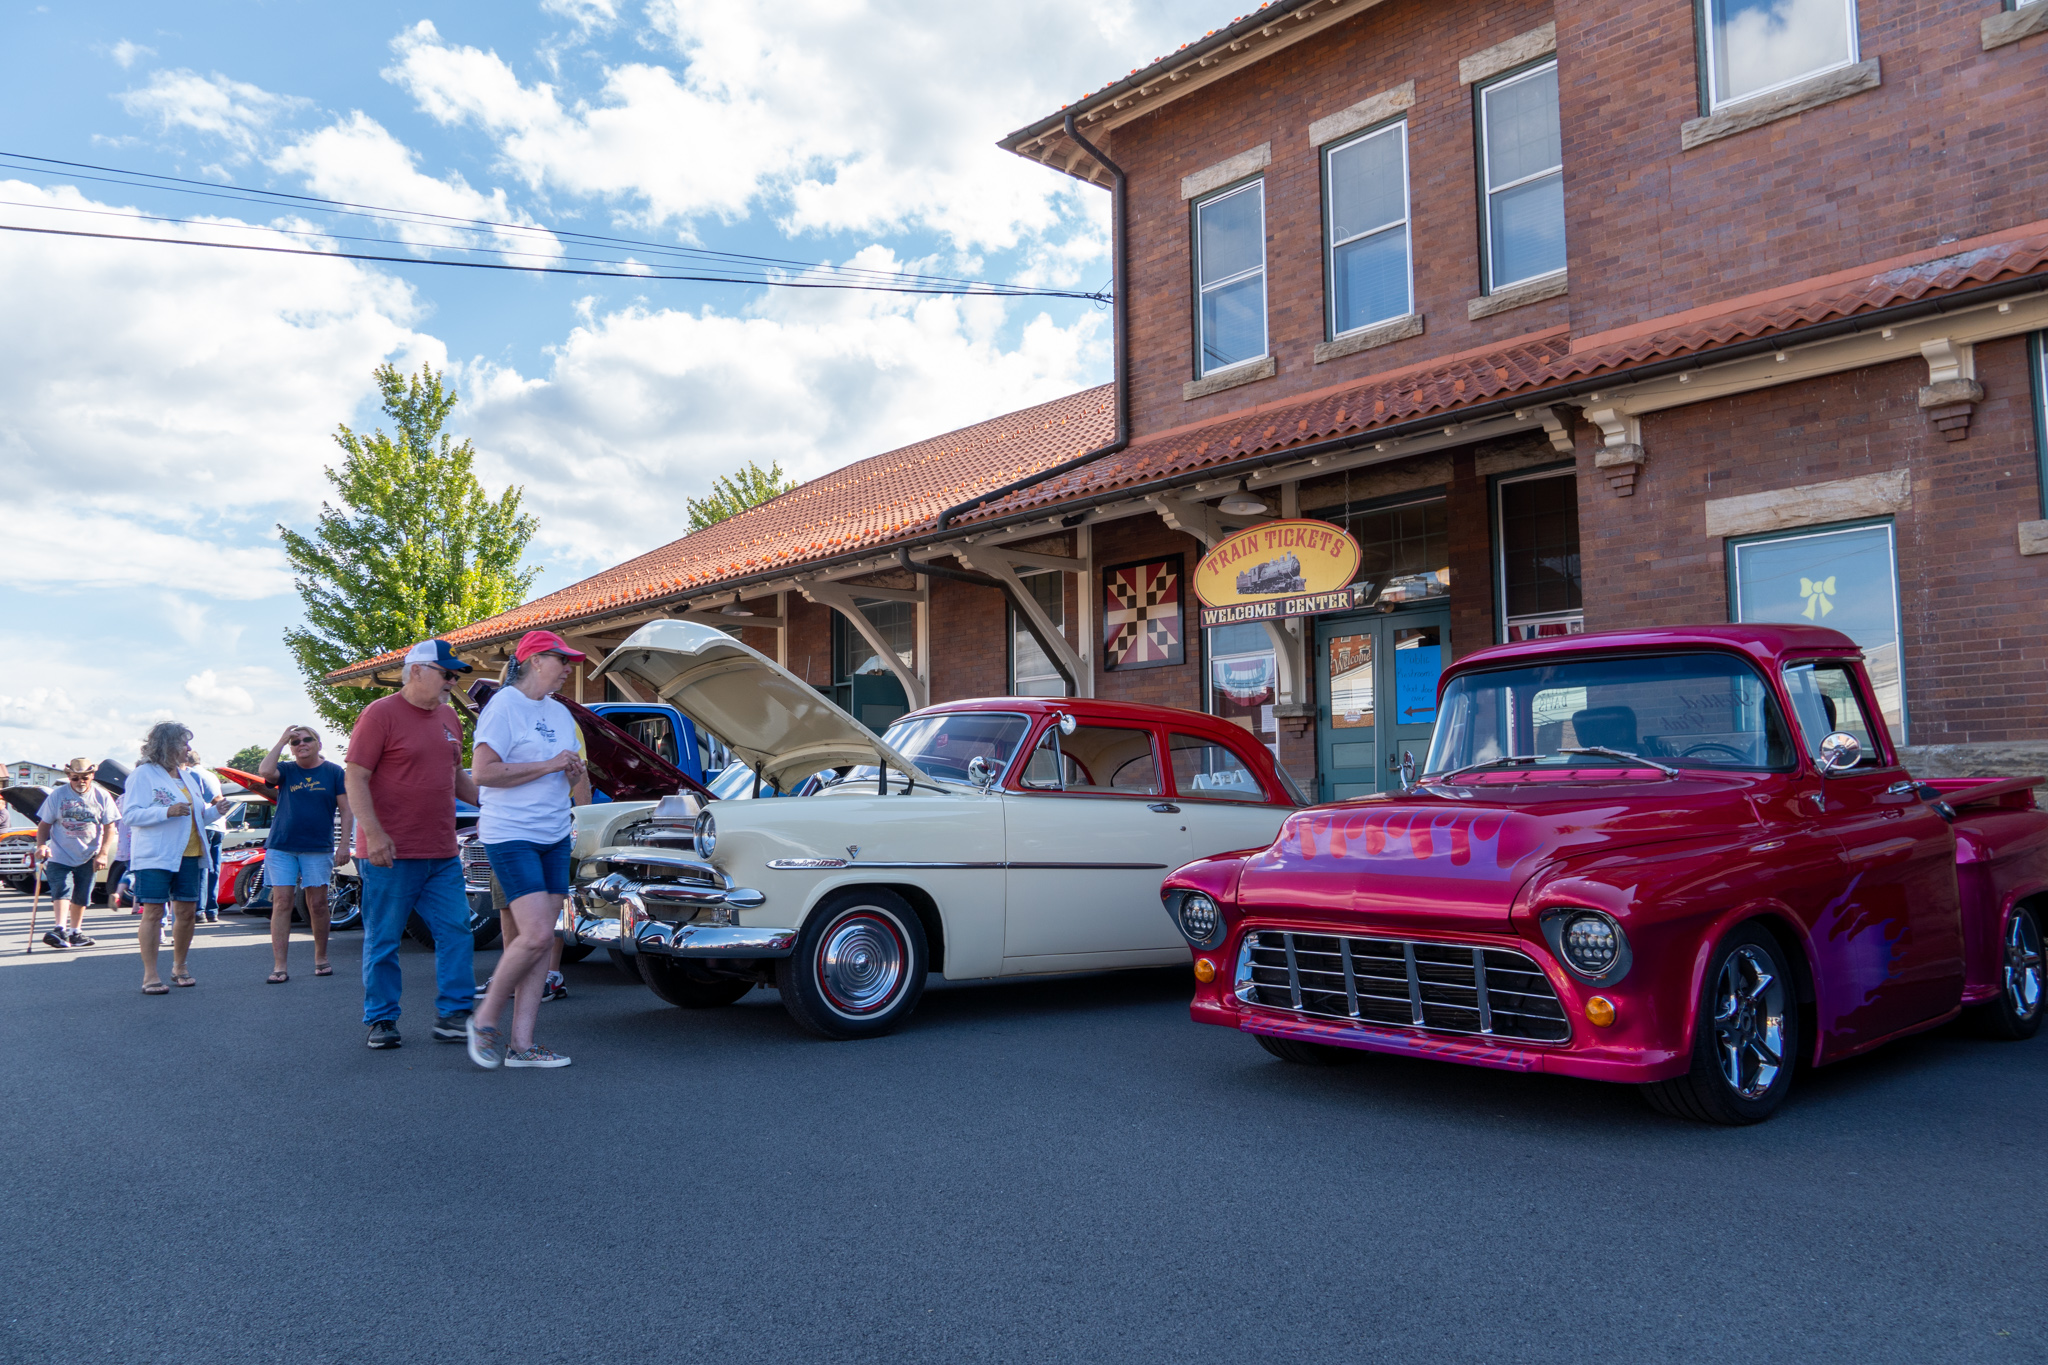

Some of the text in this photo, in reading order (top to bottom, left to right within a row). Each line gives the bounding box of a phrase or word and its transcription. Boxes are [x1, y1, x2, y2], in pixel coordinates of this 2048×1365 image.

[1206, 527, 1346, 576] TRAIN TICKETS
[1204, 592, 1350, 625] WELCOME CENTER
[1332, 652, 1371, 675] Welcome
[1403, 652, 1431, 665] Public
[1421, 683, 1434, 693] door
